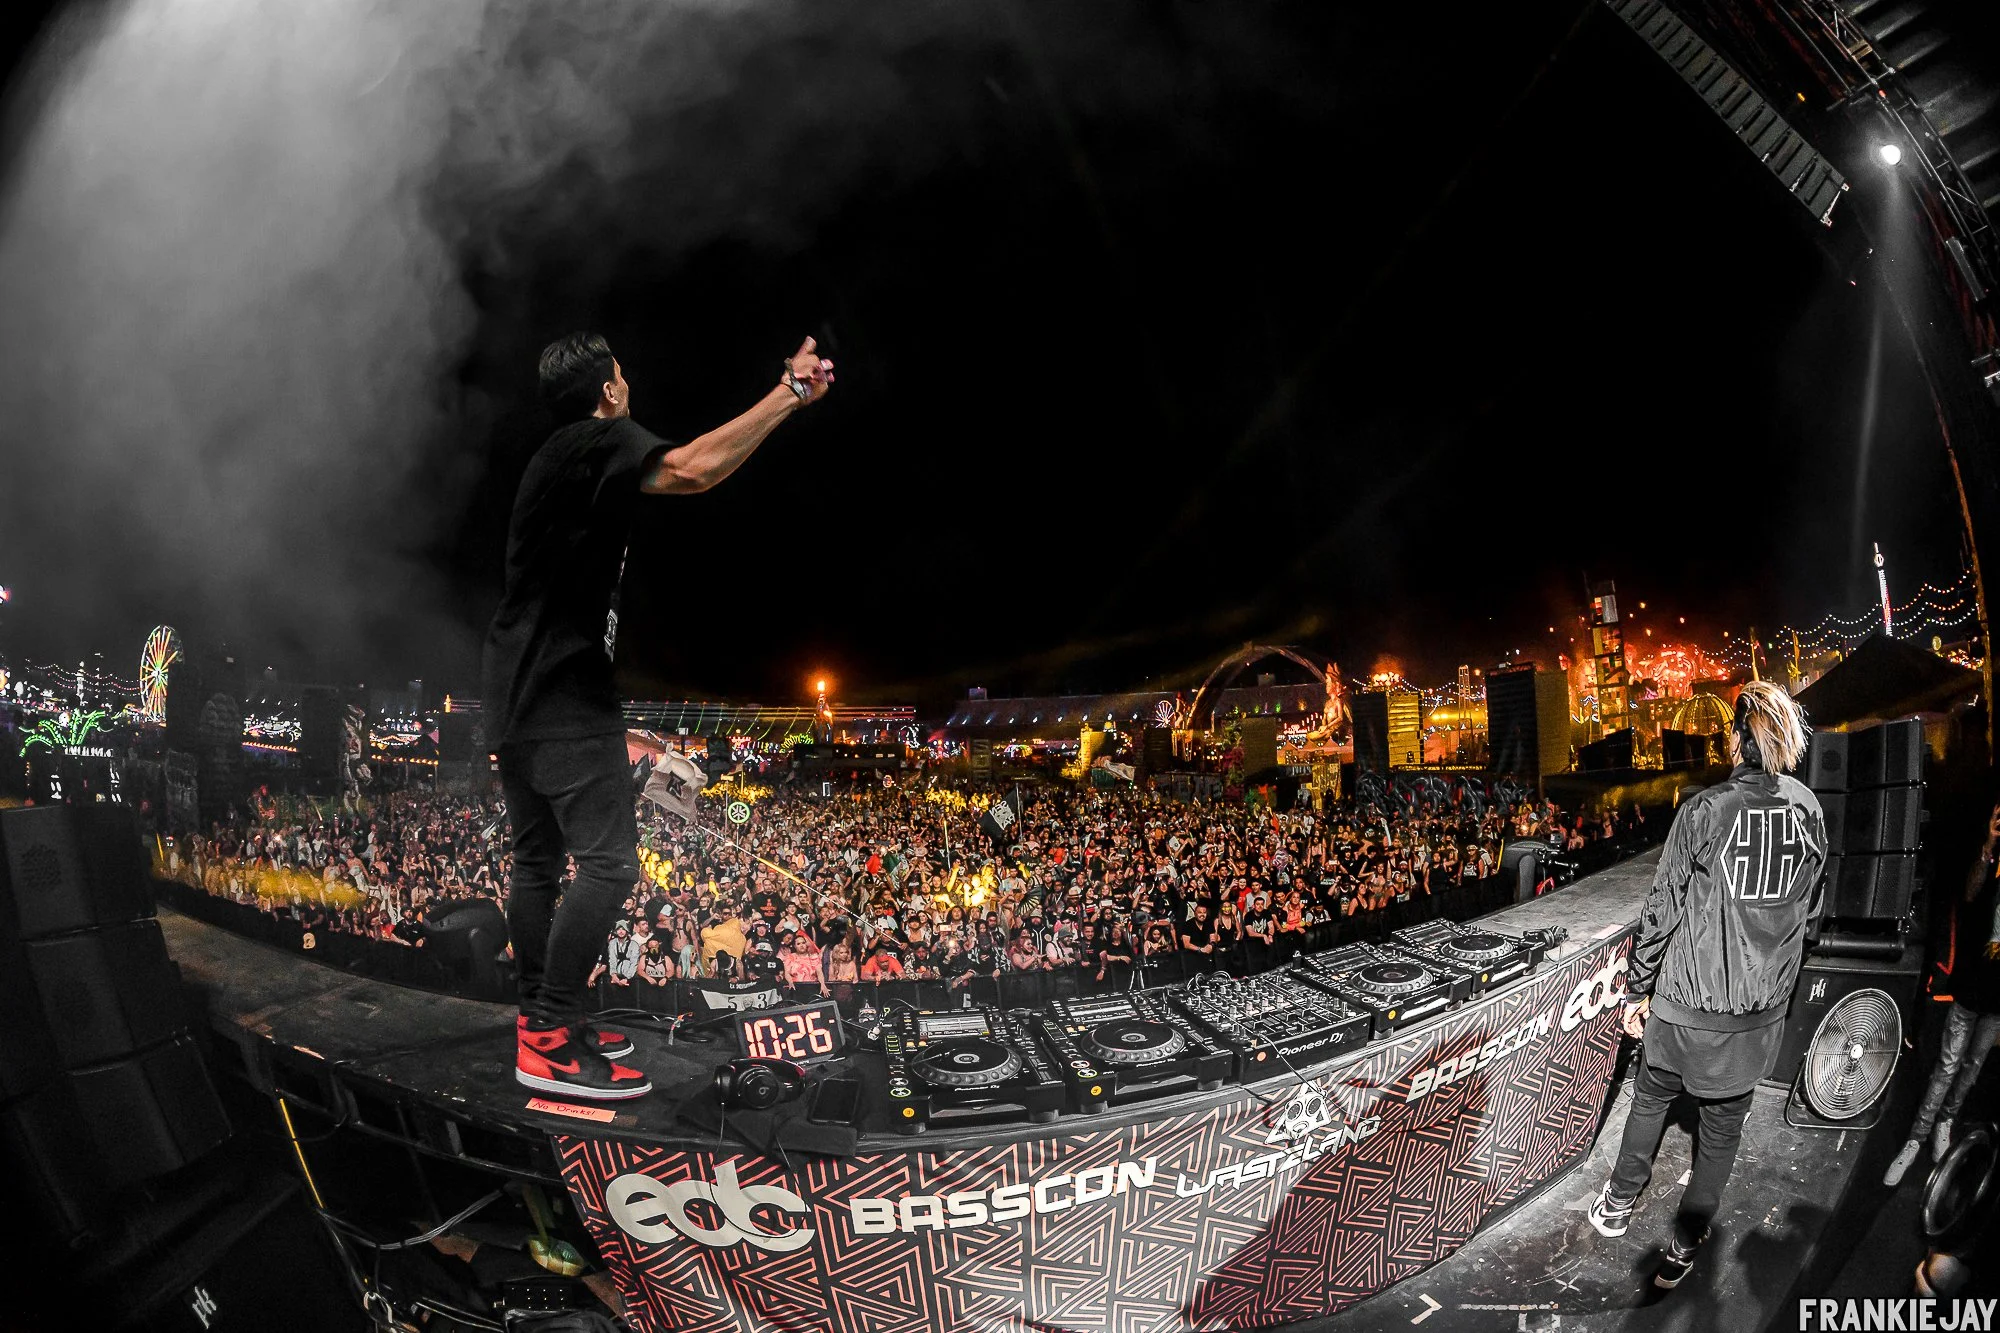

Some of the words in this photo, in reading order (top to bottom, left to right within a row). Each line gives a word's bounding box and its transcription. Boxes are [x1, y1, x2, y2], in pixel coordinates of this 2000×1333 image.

[743, 1011, 833, 1060] 10:26
[1276, 1037, 1329, 1059] Pioneer
[1406, 1009, 1552, 1104] BASSCON
[532, 1101, 549, 1110] No
[849, 1156, 1158, 1235] BASSCON
[1175, 1114, 1382, 1199] WASTELAND
[605, 1159, 816, 1253] edc
